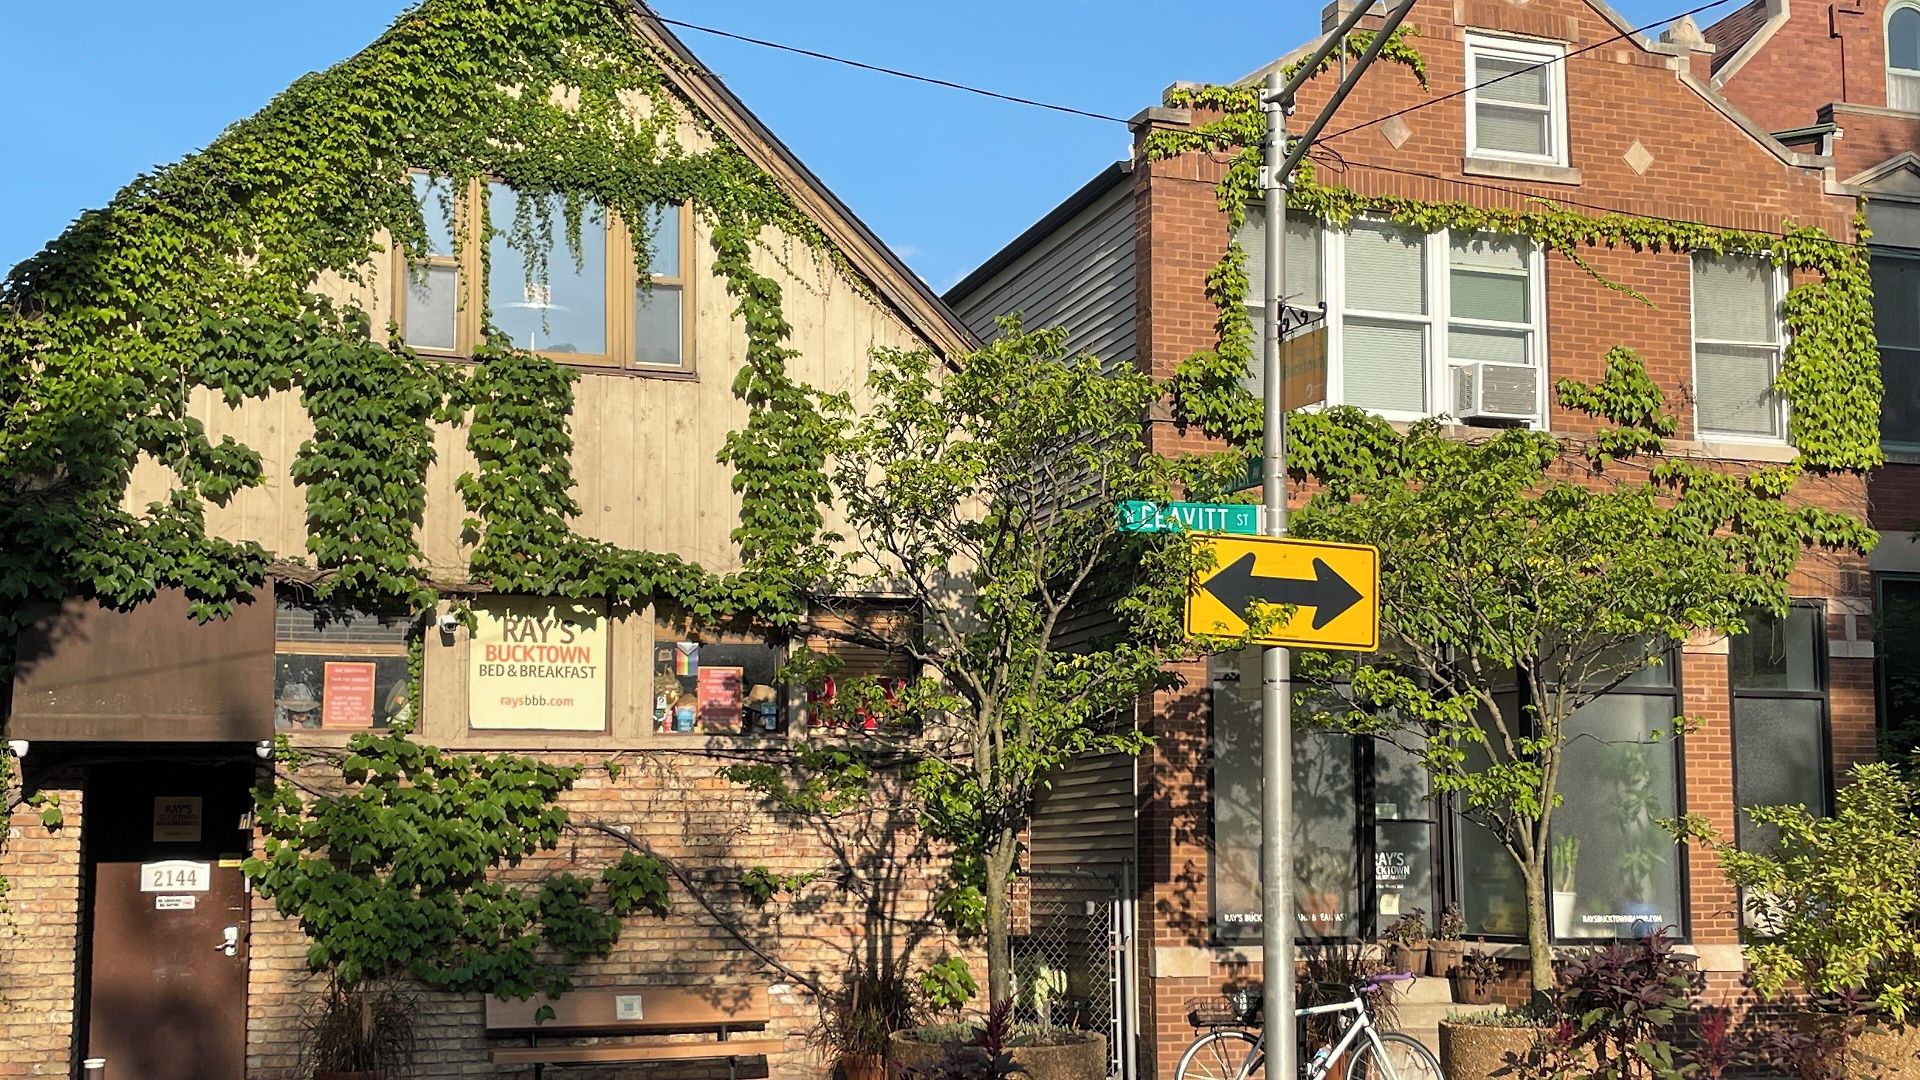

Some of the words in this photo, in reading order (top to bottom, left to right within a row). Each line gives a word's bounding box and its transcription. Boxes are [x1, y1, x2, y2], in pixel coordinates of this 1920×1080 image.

[1236, 513, 1249, 527] ST
[503, 618, 575, 644] RAY'S
[485, 644, 591, 664] BUCKTOWN
[479, 664, 505, 677] BED
[507, 664, 518, 677] &
[520, 664, 597, 679] BREAKFAST
[500, 694, 574, 708] raysbbb.com
[1375, 865, 1411, 875] CKTOWN
[153, 869, 197, 887] 2144
[1244, 913, 1263, 922] BUCK
